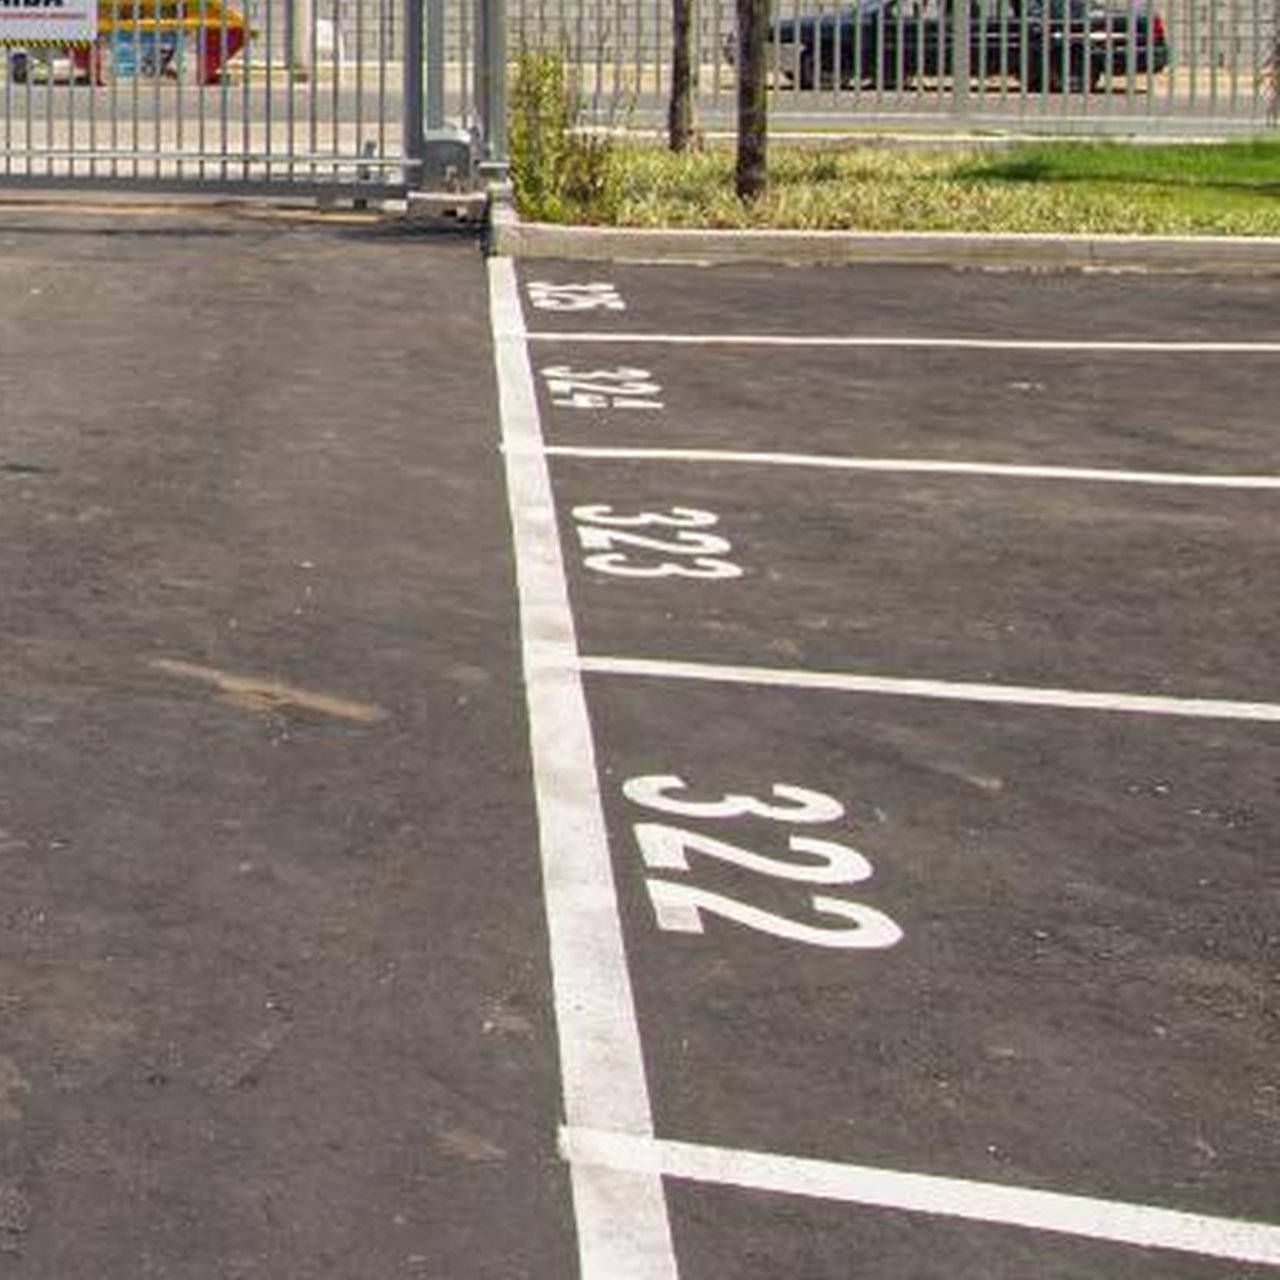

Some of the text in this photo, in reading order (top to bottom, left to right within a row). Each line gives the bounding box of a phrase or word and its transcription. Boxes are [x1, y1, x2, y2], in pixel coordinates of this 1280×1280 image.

[541, 365, 665, 409] 324
[572, 505, 742, 579] 323
[623, 774, 905, 949] 322
